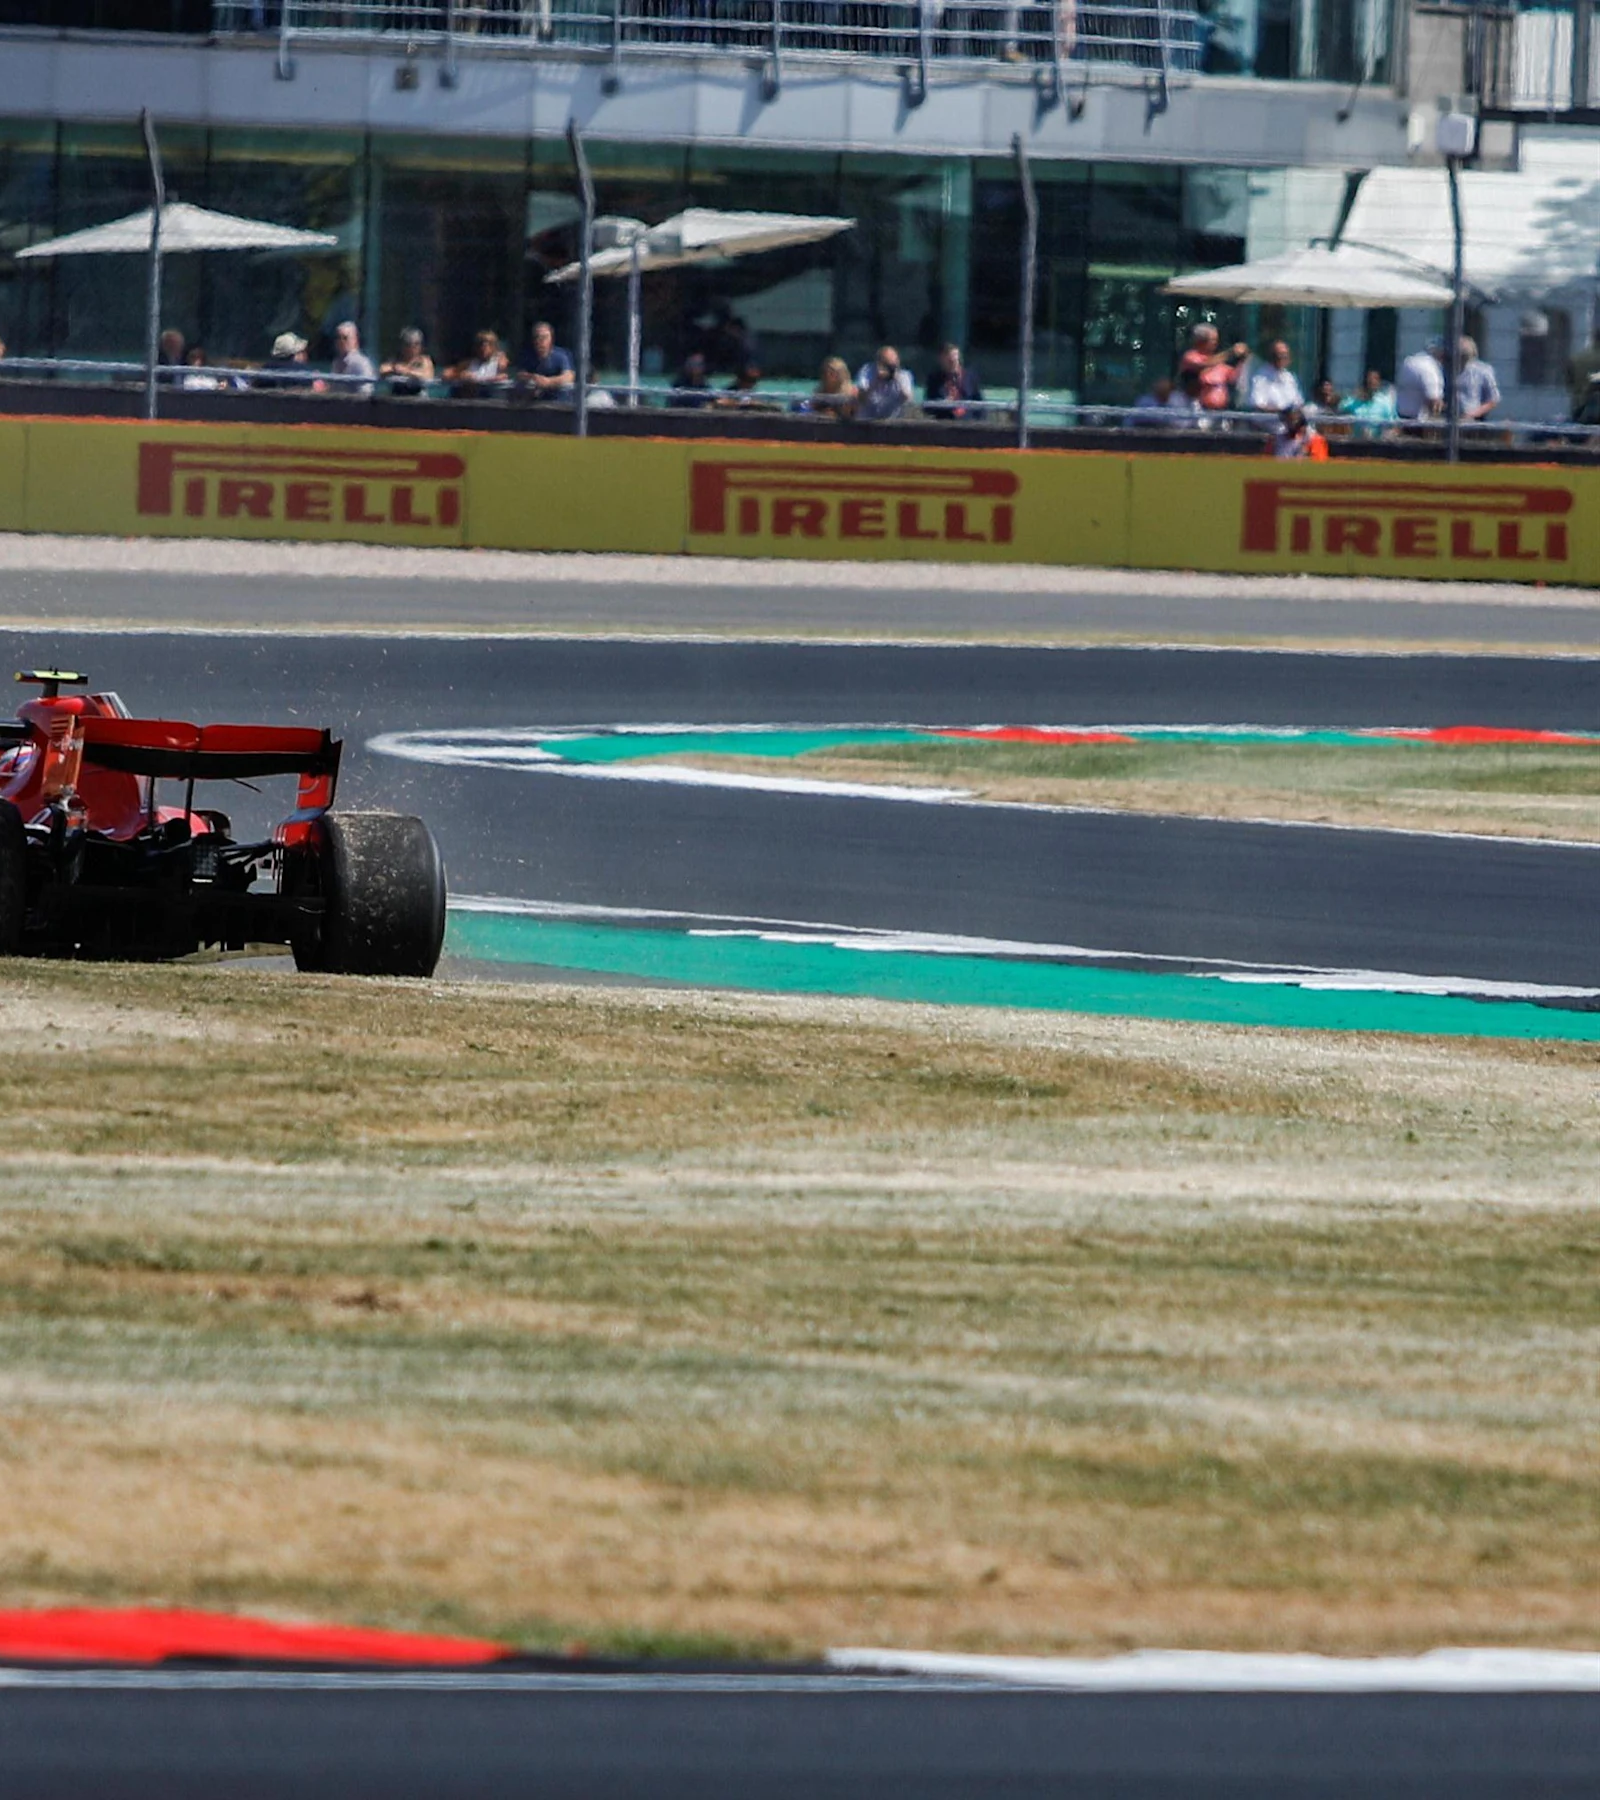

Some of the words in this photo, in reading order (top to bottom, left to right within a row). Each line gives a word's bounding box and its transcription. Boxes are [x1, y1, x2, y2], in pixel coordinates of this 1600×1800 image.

[138, 444, 466, 525] PIRELLI
[690, 464, 1019, 545] PIRELLI
[1242, 480, 1574, 561] PIRELLI
